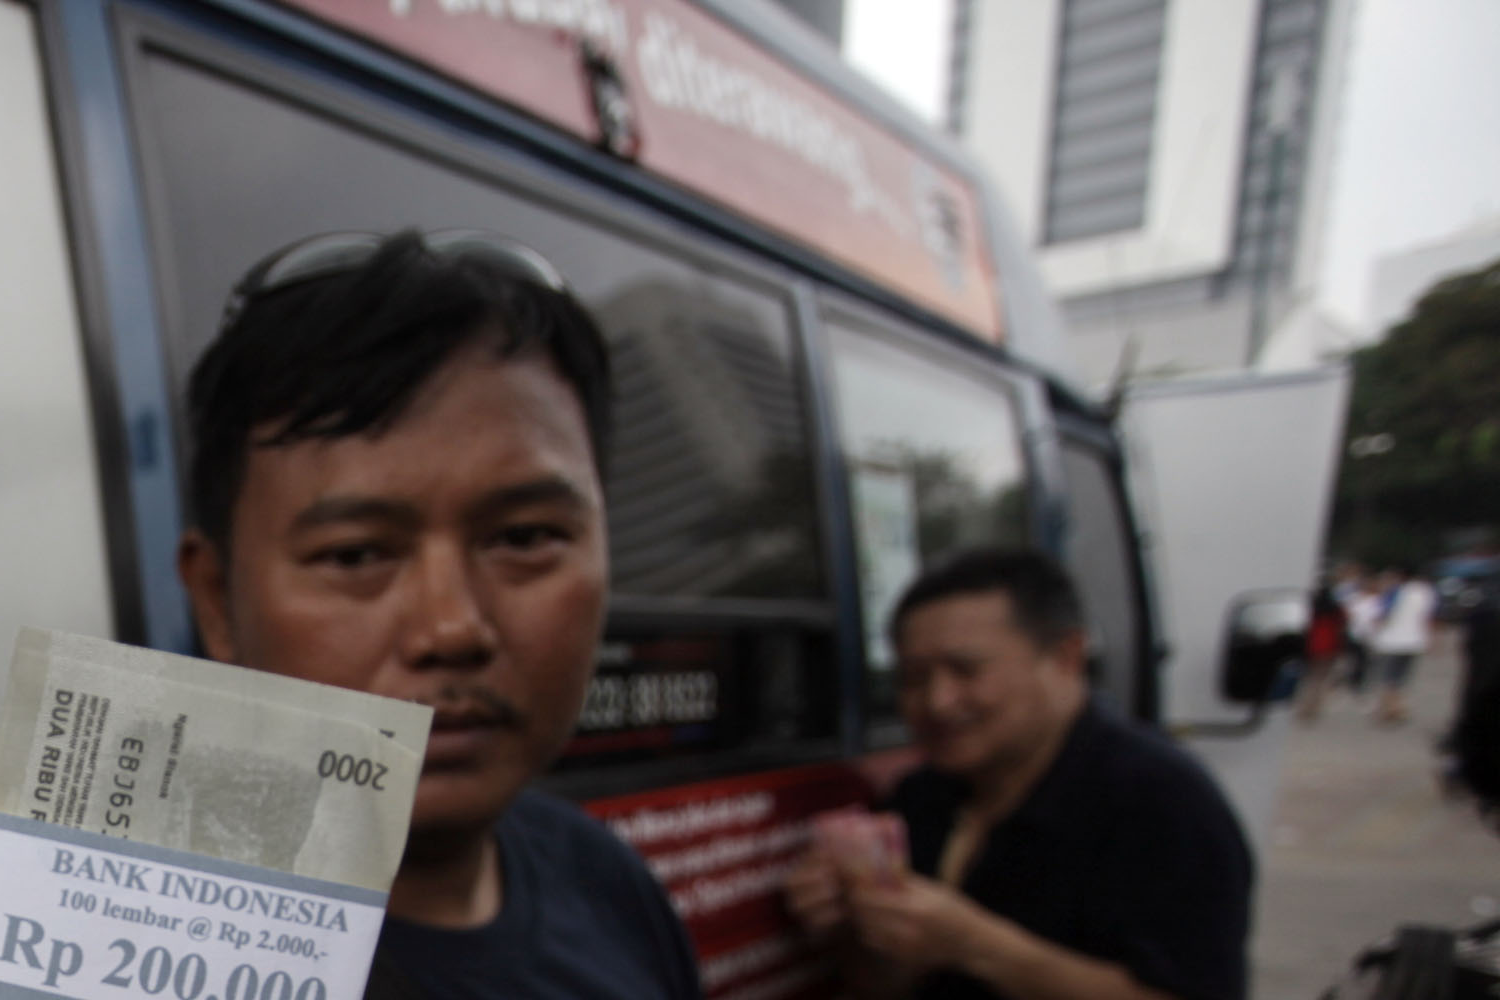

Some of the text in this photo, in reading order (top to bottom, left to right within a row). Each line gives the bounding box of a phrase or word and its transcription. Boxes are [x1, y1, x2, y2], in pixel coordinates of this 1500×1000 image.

[46, 688, 73, 741] DUA
[32, 745, 61, 803] RIBU
[100, 735, 146, 839] EBJ65
[315, 747, 389, 792] 2000
[49, 846, 353, 935] BANK INDONESIA
[56, 887, 98, 914] 100
[101, 895, 184, 934] lembar
[184, 913, 214, 944] @
[216, 921, 253, 951] Rp
